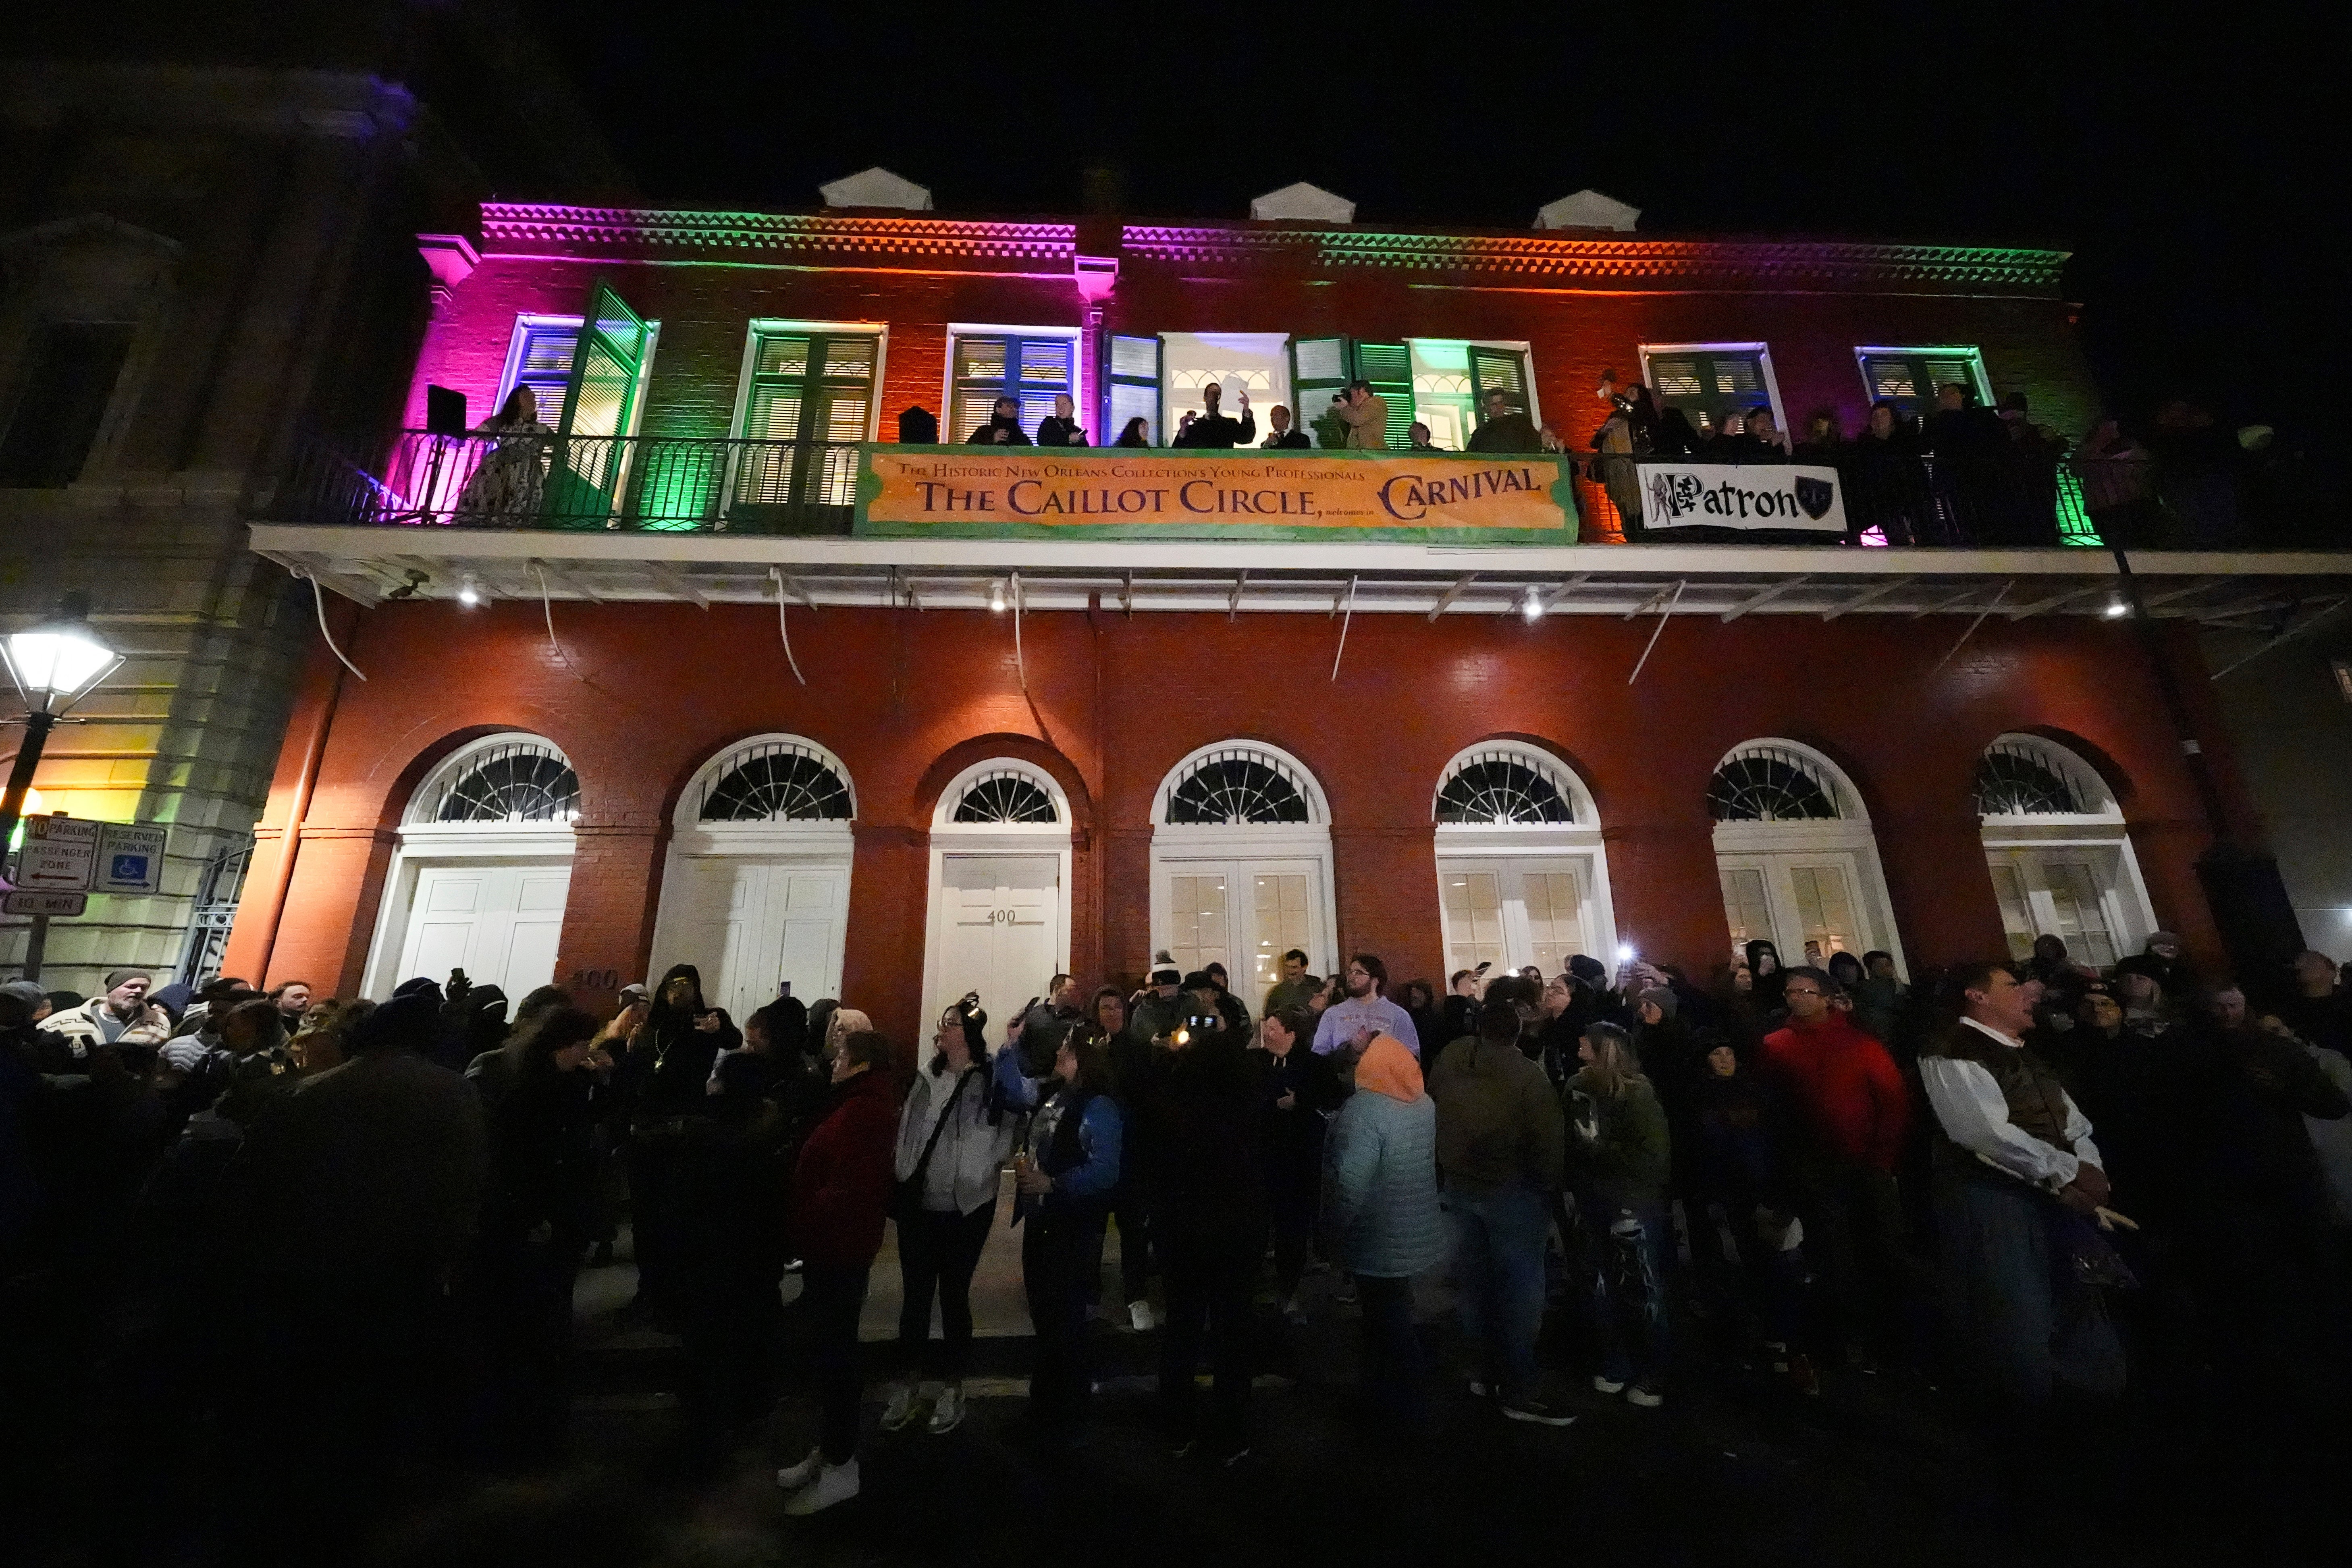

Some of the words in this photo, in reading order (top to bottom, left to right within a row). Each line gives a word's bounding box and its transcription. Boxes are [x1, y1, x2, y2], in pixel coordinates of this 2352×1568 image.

[898, 463, 927, 476] THE
[933, 463, 1001, 478] HISTORIC
[1004, 465, 1041, 478] NEW
[1044, 464, 1107, 478] ORLEANS
[1111, 465, 1206, 478] COLLECTION'S
[1211, 466, 1261, 478] YOUNG
[1265, 466, 1365, 482] PROFESSIONALS
[916, 482, 995, 511] THE
[1008, 481, 1170, 515] CAILLOT
[1180, 480, 1323, 520] CIRCLE,
[1377, 468, 1541, 520] CARNIVAL
[1663, 473, 1799, 518] Patron
[50, 824, 95, 837] PARKING
[107, 841, 156, 854] PARKING
[987, 910, 1015, 923] 400
